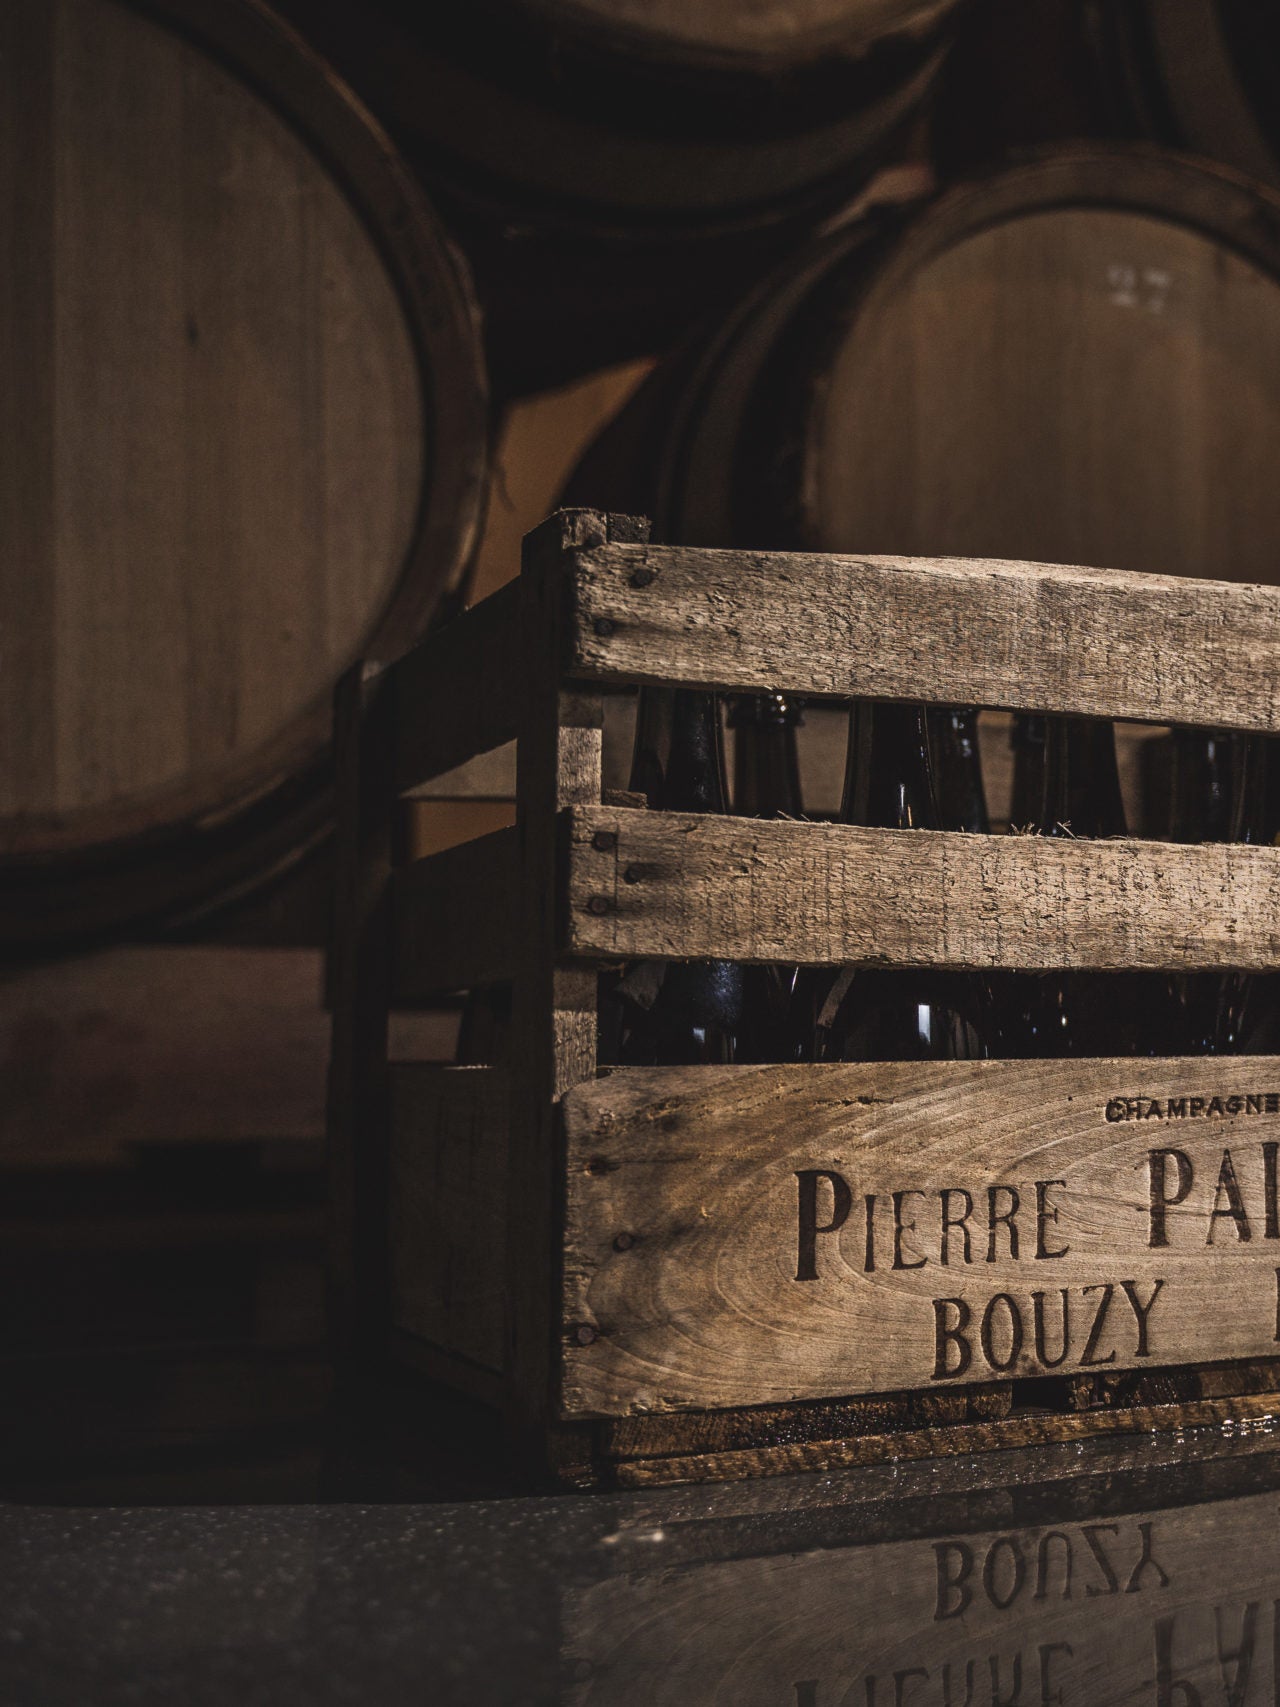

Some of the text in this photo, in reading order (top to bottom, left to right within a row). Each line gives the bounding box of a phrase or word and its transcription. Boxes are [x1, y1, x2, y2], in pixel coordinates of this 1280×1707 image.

[1105, 1093, 1280, 1122] CHAMPAGNE
[794, 1169, 1070, 1281] PIERRE
[931, 1279, 1164, 1380] BOUZY
